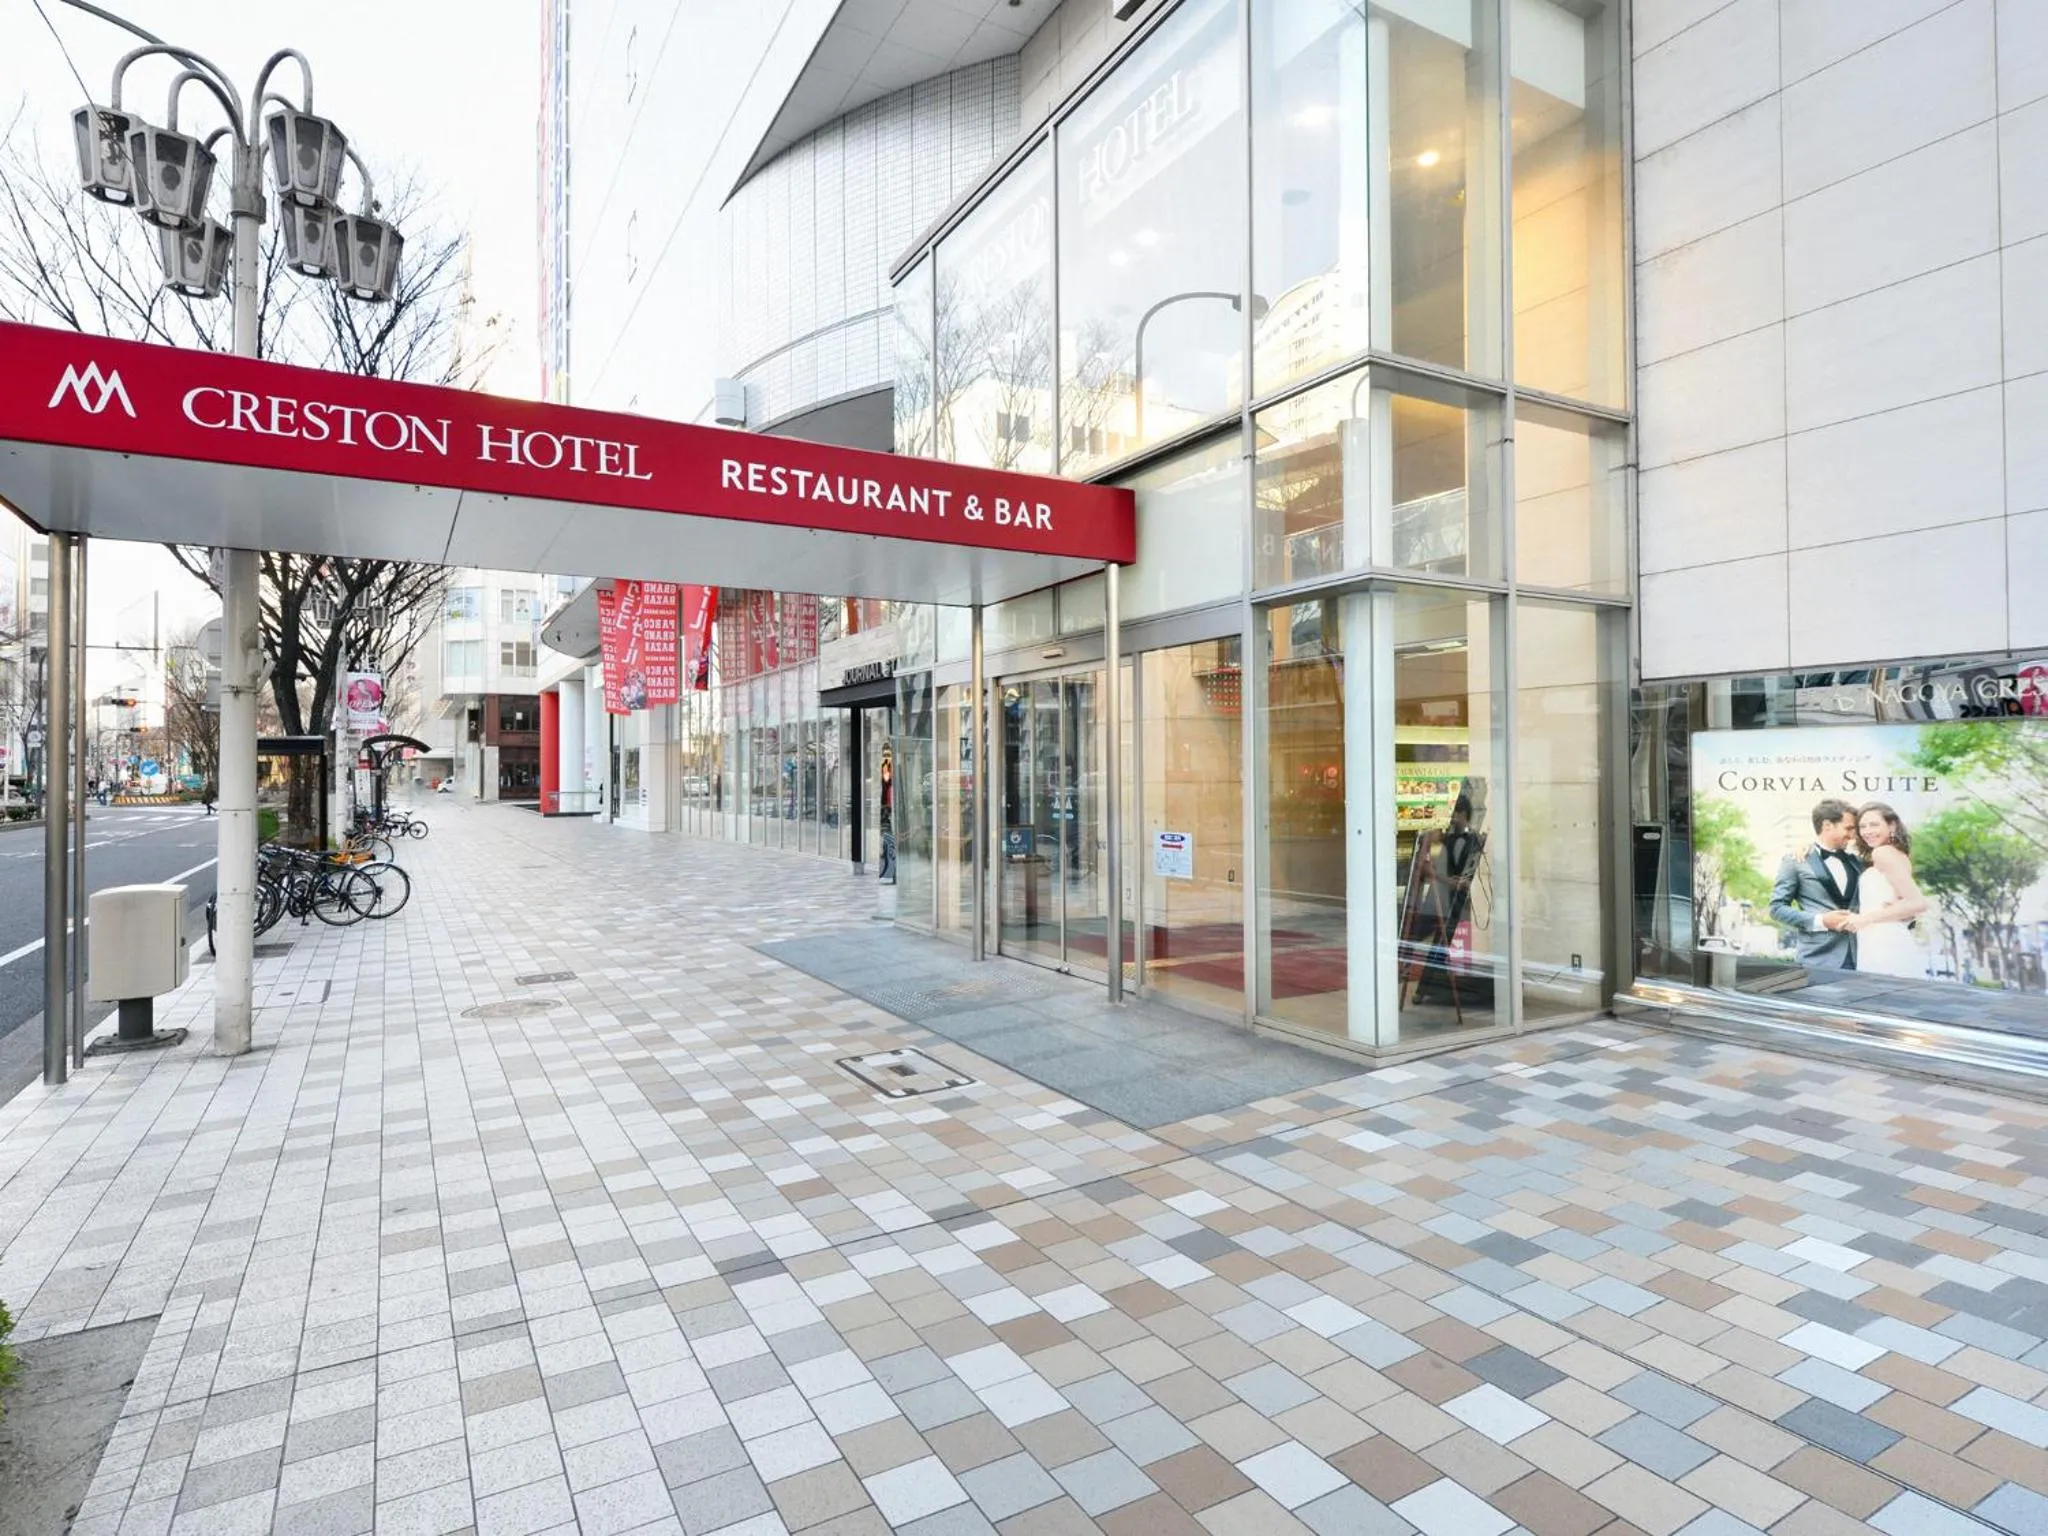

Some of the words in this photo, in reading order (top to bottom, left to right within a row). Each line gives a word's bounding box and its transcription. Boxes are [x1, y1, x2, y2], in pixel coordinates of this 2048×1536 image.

[1077, 69, 1195, 207] HOTEL
[183, 387, 451, 456] CRESTON
[477, 424, 653, 483] HOTEL
[722, 458, 953, 518] RESTAURANT
[963, 494, 985, 522] &
[994, 497, 1054, 532] BAR
[842, 661, 885, 686] JOURNAL
[1866, 683, 1969, 706] NAGOYA
[1718, 770, 1826, 792] CORVIA
[1842, 769, 1940, 792] SUITE
